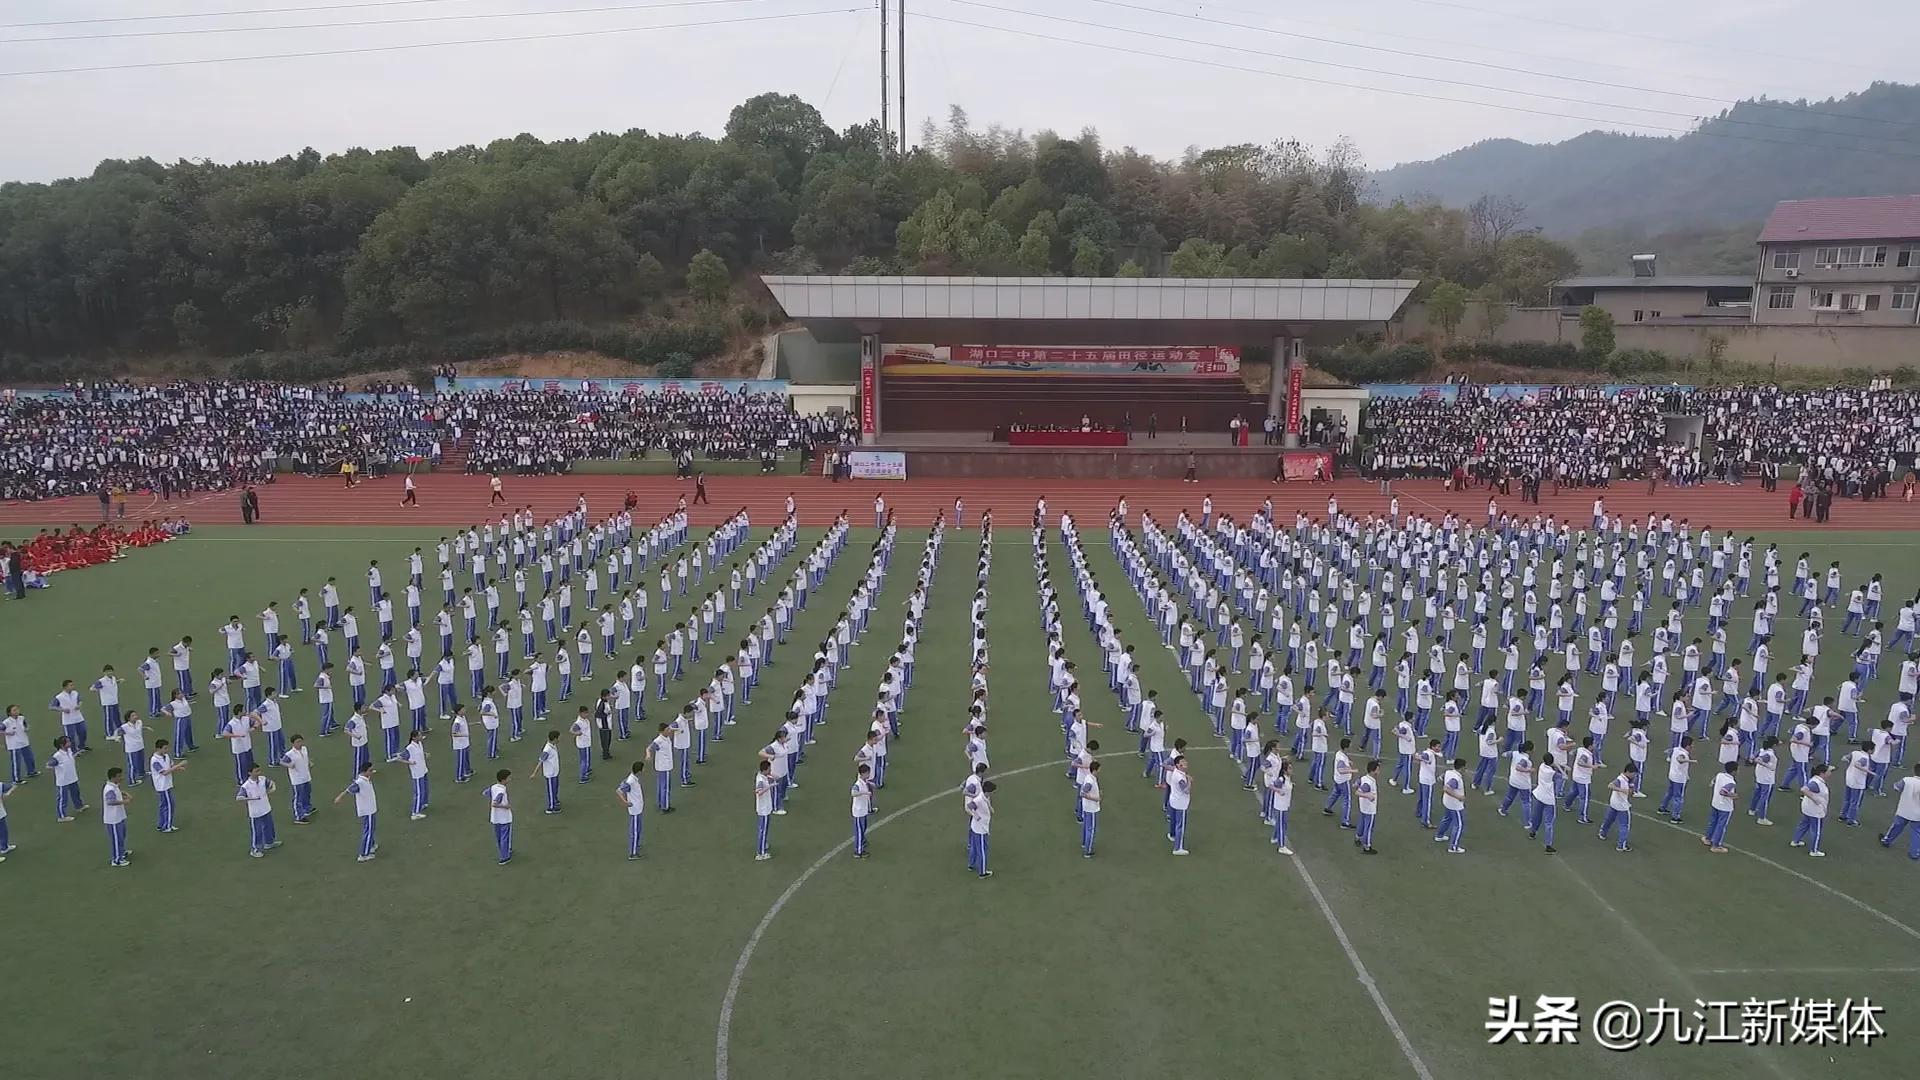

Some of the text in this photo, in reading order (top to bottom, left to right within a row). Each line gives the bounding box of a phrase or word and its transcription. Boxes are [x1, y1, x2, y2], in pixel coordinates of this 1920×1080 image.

[968, 348, 1201, 361] 湖口二中第二十五届田径运动会
